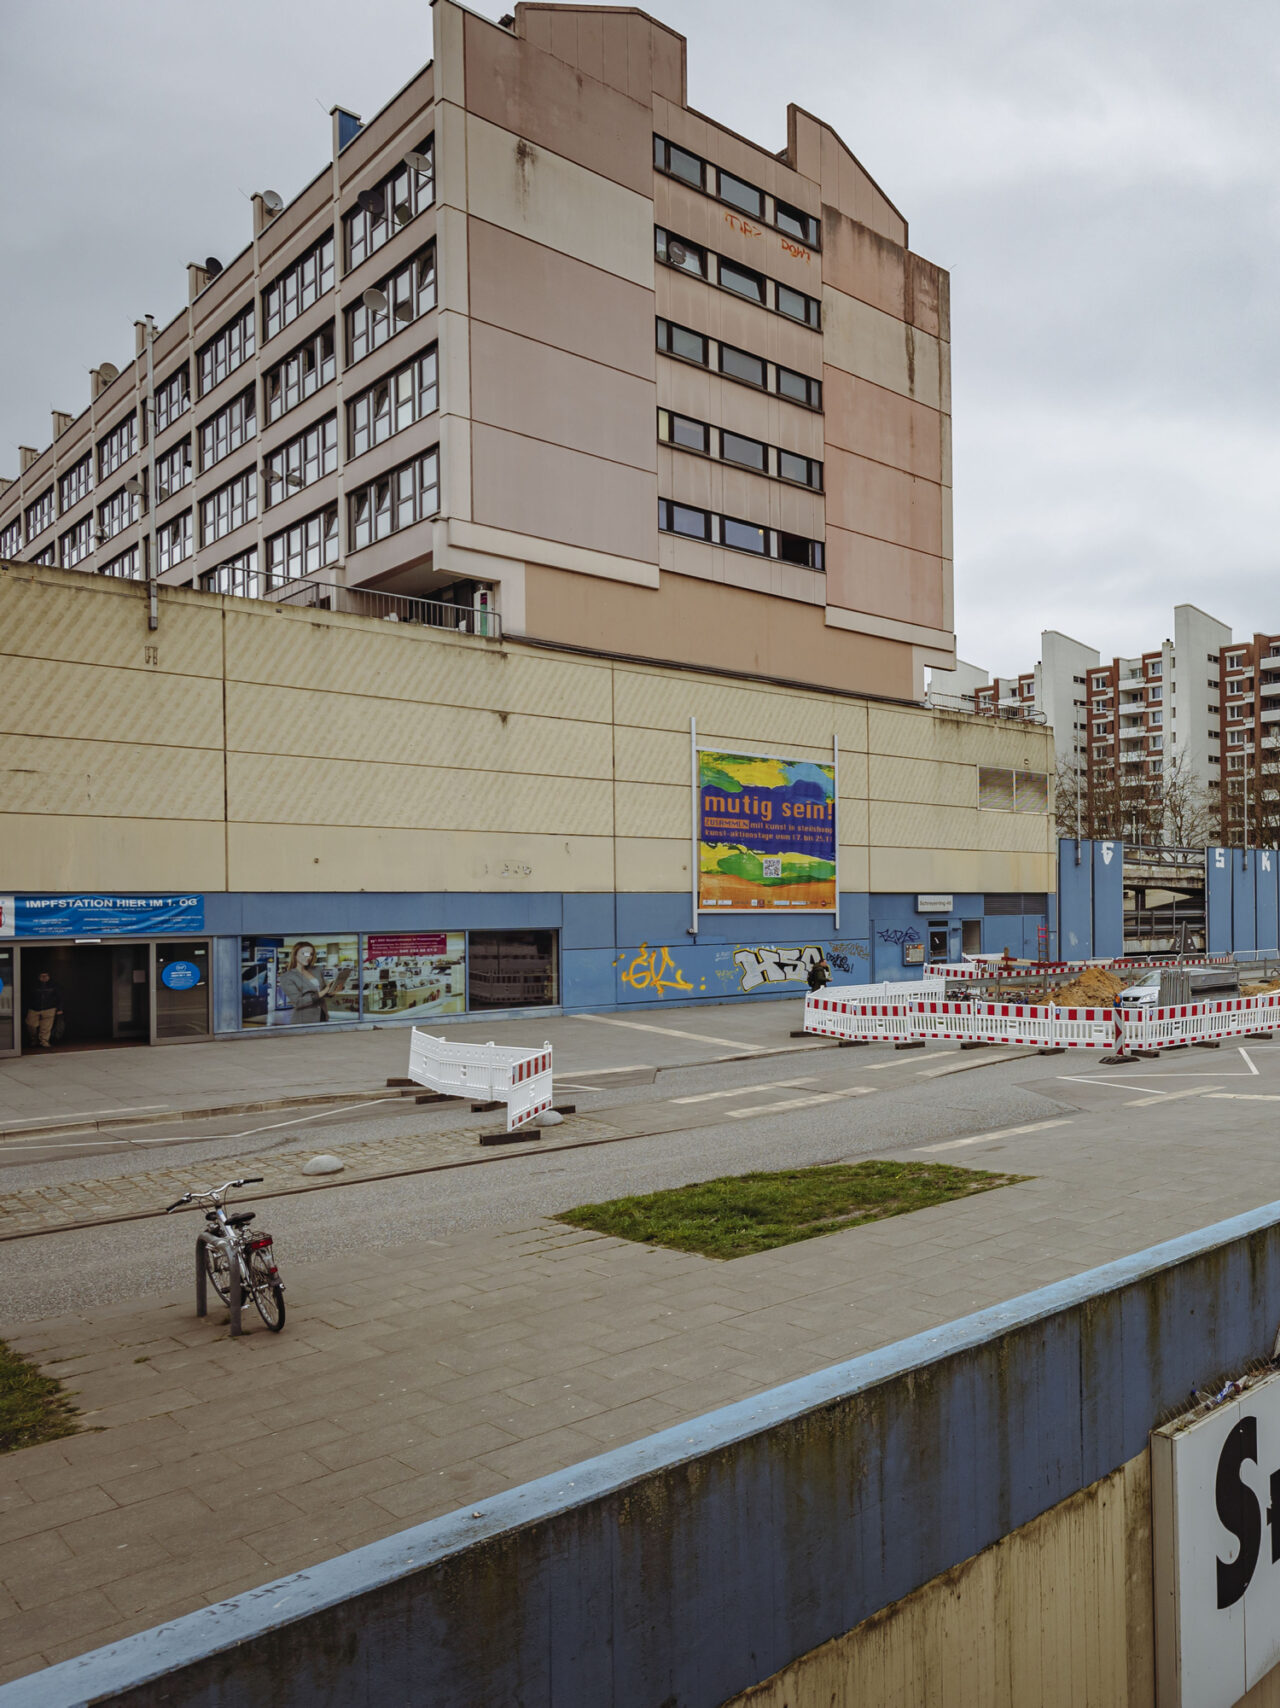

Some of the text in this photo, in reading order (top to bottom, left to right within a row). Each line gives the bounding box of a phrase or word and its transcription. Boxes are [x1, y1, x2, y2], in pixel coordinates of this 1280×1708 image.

[705, 795, 832, 821] mutig sein!
[750, 821, 763, 829] mit
[765, 821, 786, 830] kunst
[25, 898, 197, 908] IMPFSTATION HIER IM 1. OG
